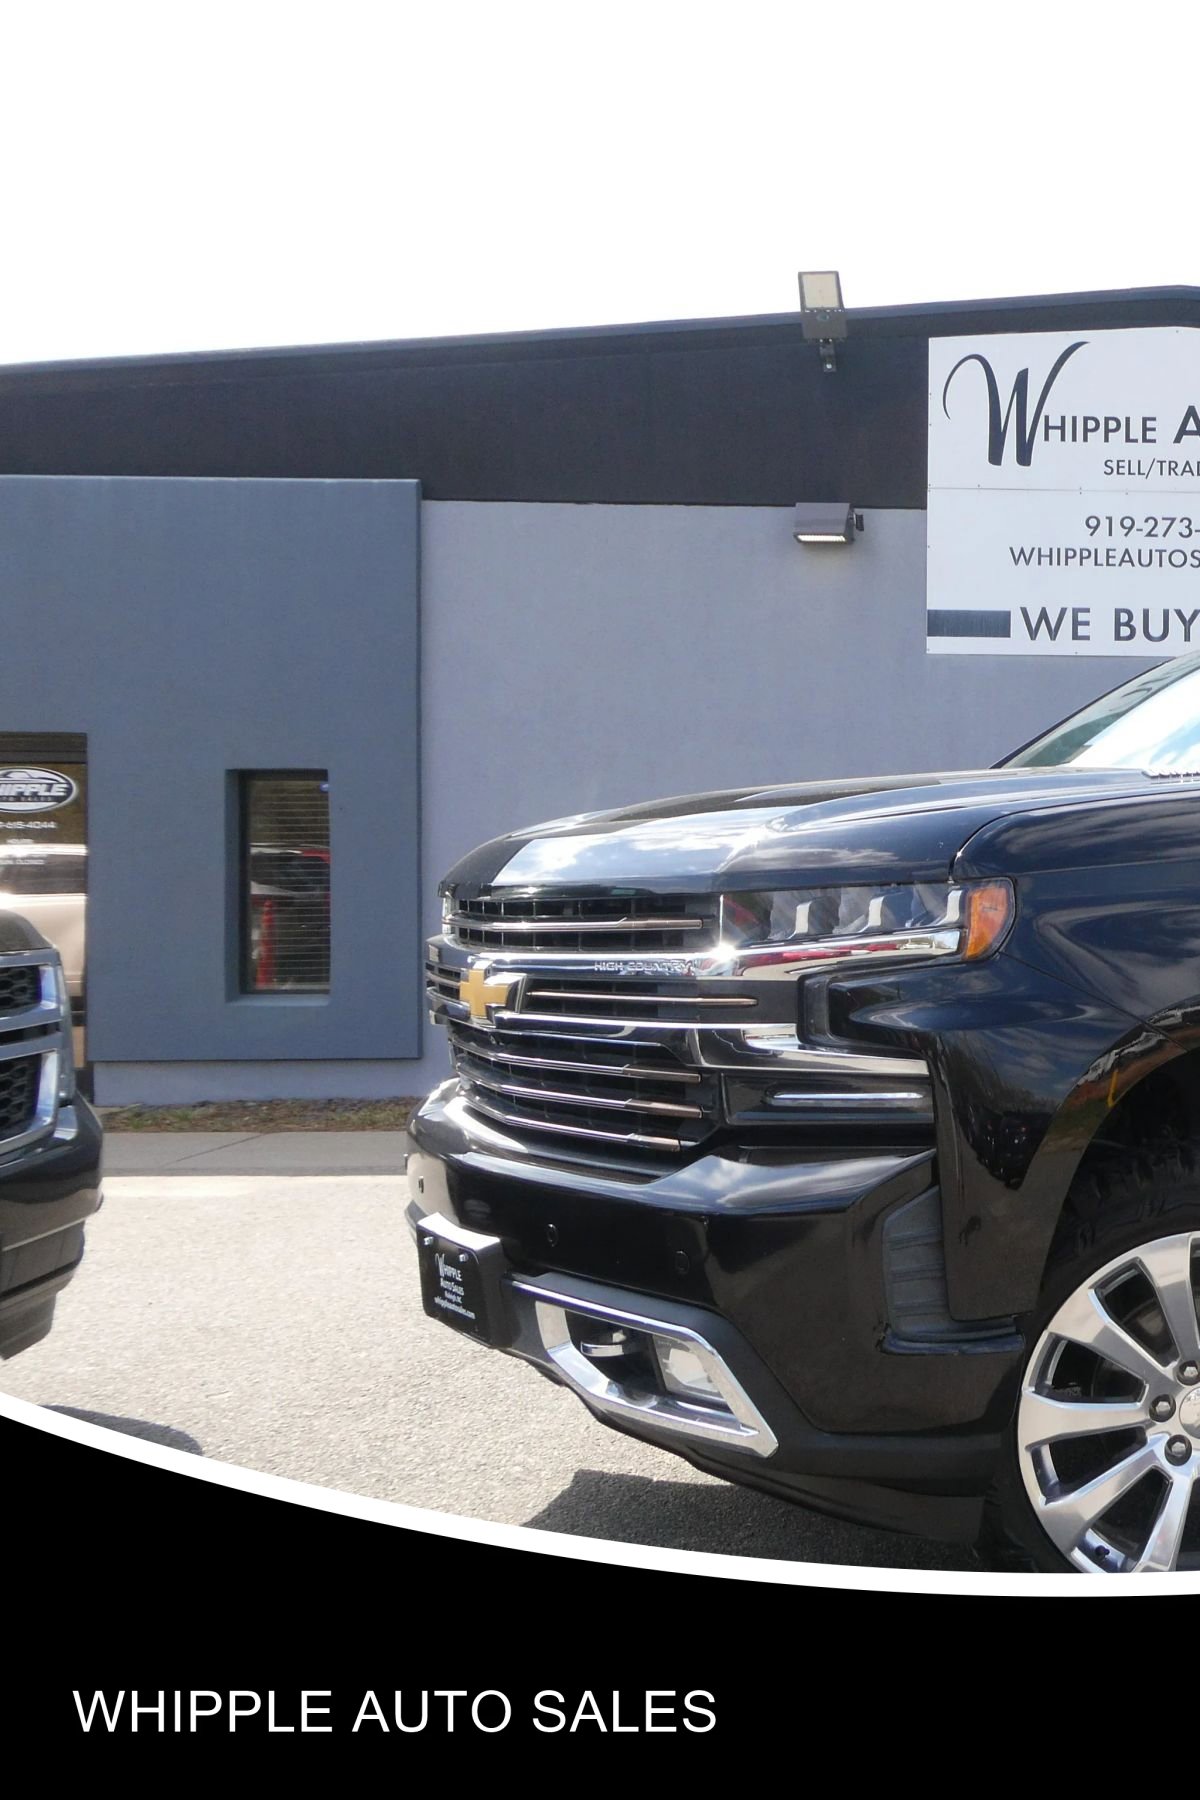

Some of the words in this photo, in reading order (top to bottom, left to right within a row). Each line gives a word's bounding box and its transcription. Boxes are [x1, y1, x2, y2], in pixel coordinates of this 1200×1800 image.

[942, 341, 1158, 467] WHIPPLE
[1020, 607, 1091, 641] WE
[594, 962, 623, 971] HIGH
